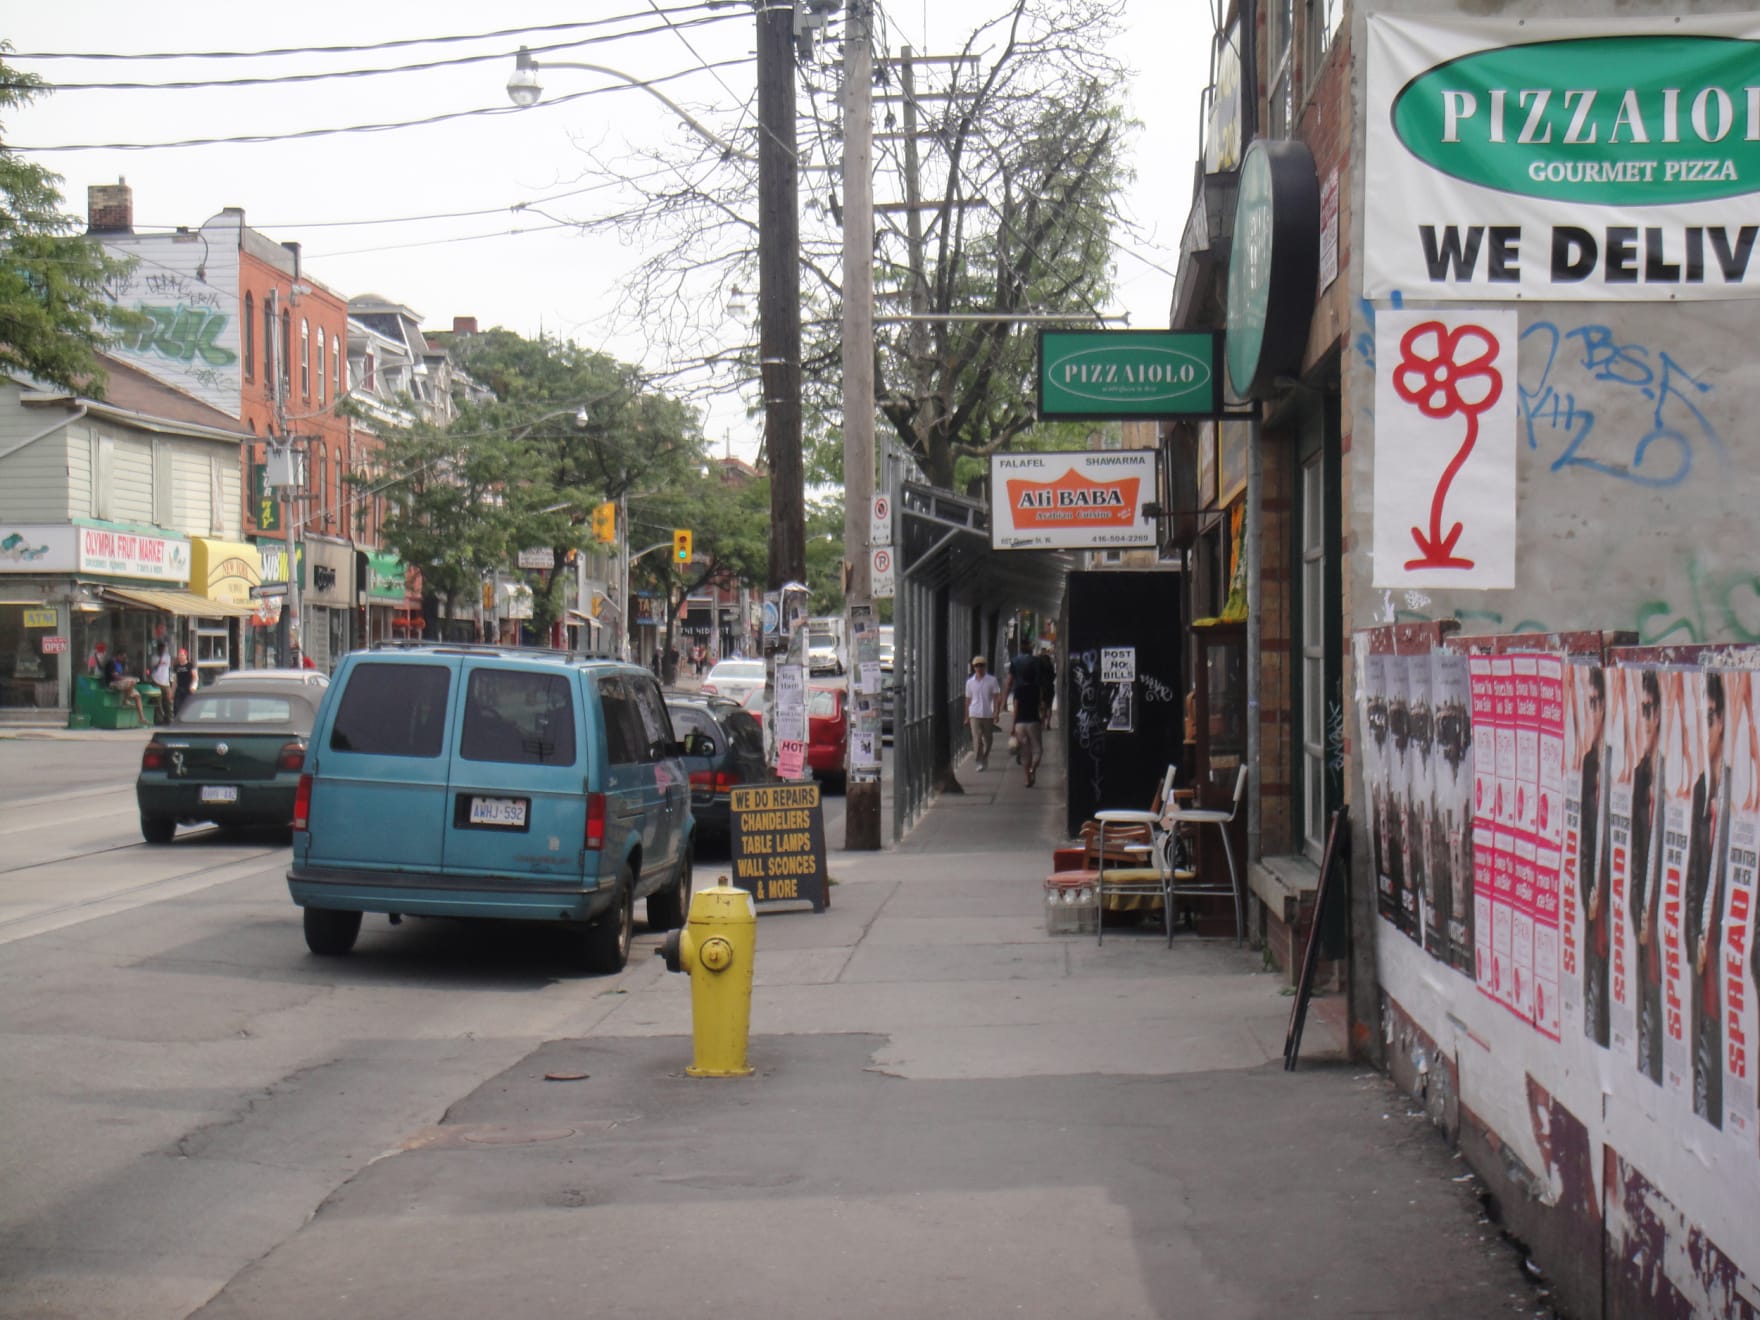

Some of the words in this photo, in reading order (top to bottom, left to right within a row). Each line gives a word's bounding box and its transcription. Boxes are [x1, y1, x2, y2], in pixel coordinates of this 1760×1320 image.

[1528, 161, 1657, 182] GOURMET
[1664, 160, 1738, 181] PIZZA
[1418, 225, 1522, 283] WE
[1550, 225, 1760, 283] DELIV
[1064, 364, 1195, 383] PIZZAIOLO
[1000, 459, 1046, 468] FALAFEL
[1085, 456, 1146, 466] SHAWARMA
[1020, 490, 1053, 507] Ali
[1059, 490, 1123, 506] BABA
[86, 530, 115, 558] OLYMPIA
[117, 535, 136, 560] FRUIT
[139, 538, 165, 563] MARKET
[1104, 650, 1132, 658] POST
[1110, 661, 1126, 669] NO
[782, 742, 803, 753] HOT
[735, 792, 750, 809] WE
[755, 791, 768, 807] DO
[773, 788, 815, 806] REPAIRS
[741, 810, 810, 832] CHANDELIERS
[741, 834, 773, 854] TABLE
[776, 832, 811, 853] LAMPS
[737, 858, 765, 877] WALL
[768, 855, 816, 876] SCONCES
[757, 880, 765, 899] &
[769, 879, 798, 898] MORE
[1563, 830, 1577, 976] SPREAD
[1612, 848, 1626, 1005] SPREAD
[1664, 868, 1682, 1041] SPREAD
[1726, 888, 1750, 1079] SPREAD
